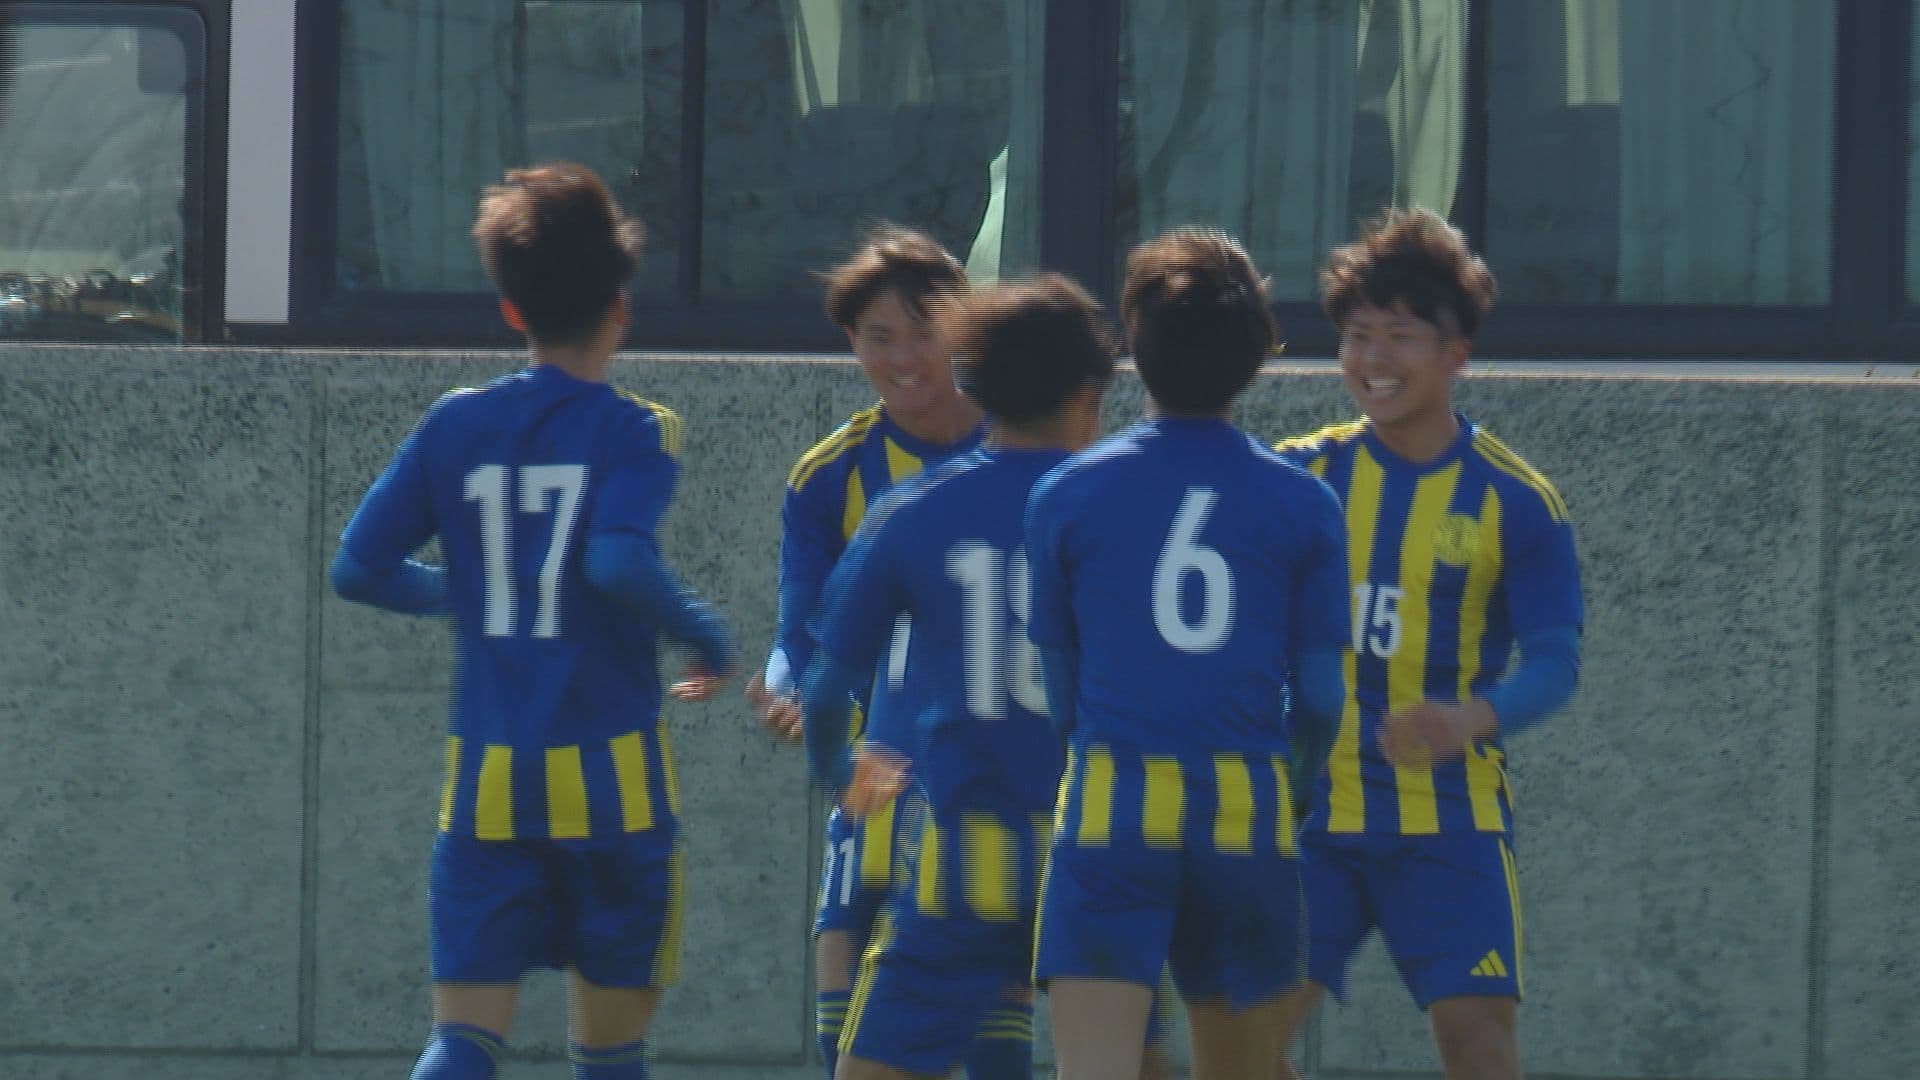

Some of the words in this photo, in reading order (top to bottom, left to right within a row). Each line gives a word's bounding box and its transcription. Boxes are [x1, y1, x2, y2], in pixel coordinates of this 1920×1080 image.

[462, 464, 590, 638] 17
[1151, 486, 1235, 653] 6
[1351, 583, 1406, 658] 15
